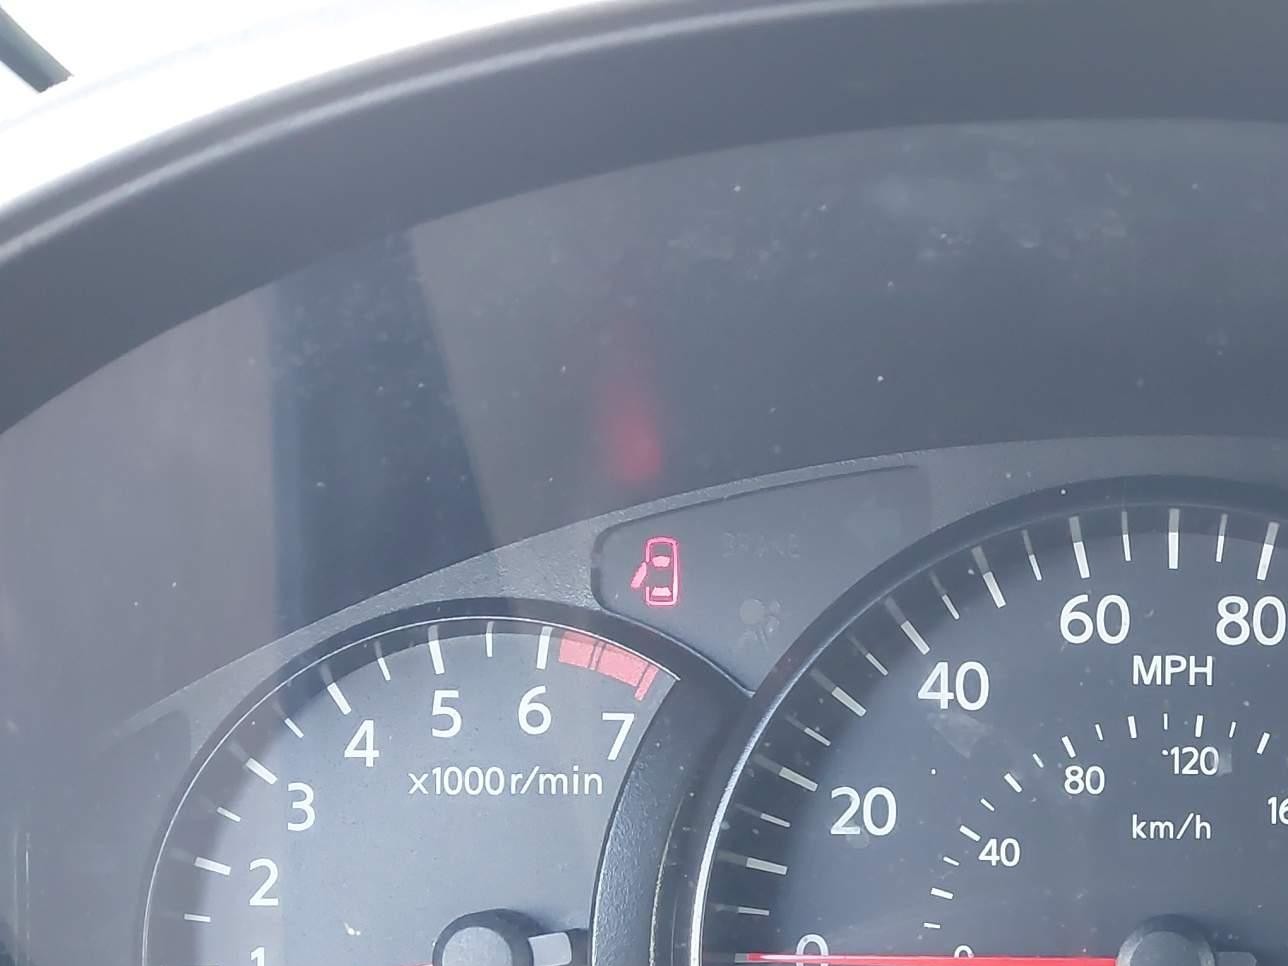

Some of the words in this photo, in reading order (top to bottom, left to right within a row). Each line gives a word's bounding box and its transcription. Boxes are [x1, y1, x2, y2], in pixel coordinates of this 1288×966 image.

[1060, 594, 1130, 645] 60
[1216, 595, 1286, 646] 80
[917, 661, 990, 711] 40
[1132, 654, 1213, 686] MPH
[431, 689, 462, 739] 5
[518, 685, 552, 735] 6
[343, 719, 380, 768] 4
[602, 712, 635, 761] 7
[1170, 746, 1220, 776] 120
[1064, 765, 1105, 795] 80
[287, 782, 316, 832] 3
[830, 786, 897, 836] 20
[1132, 812, 1211, 840] km/h
[978, 838, 1021, 867] 40
[249, 858, 279, 906] 2
